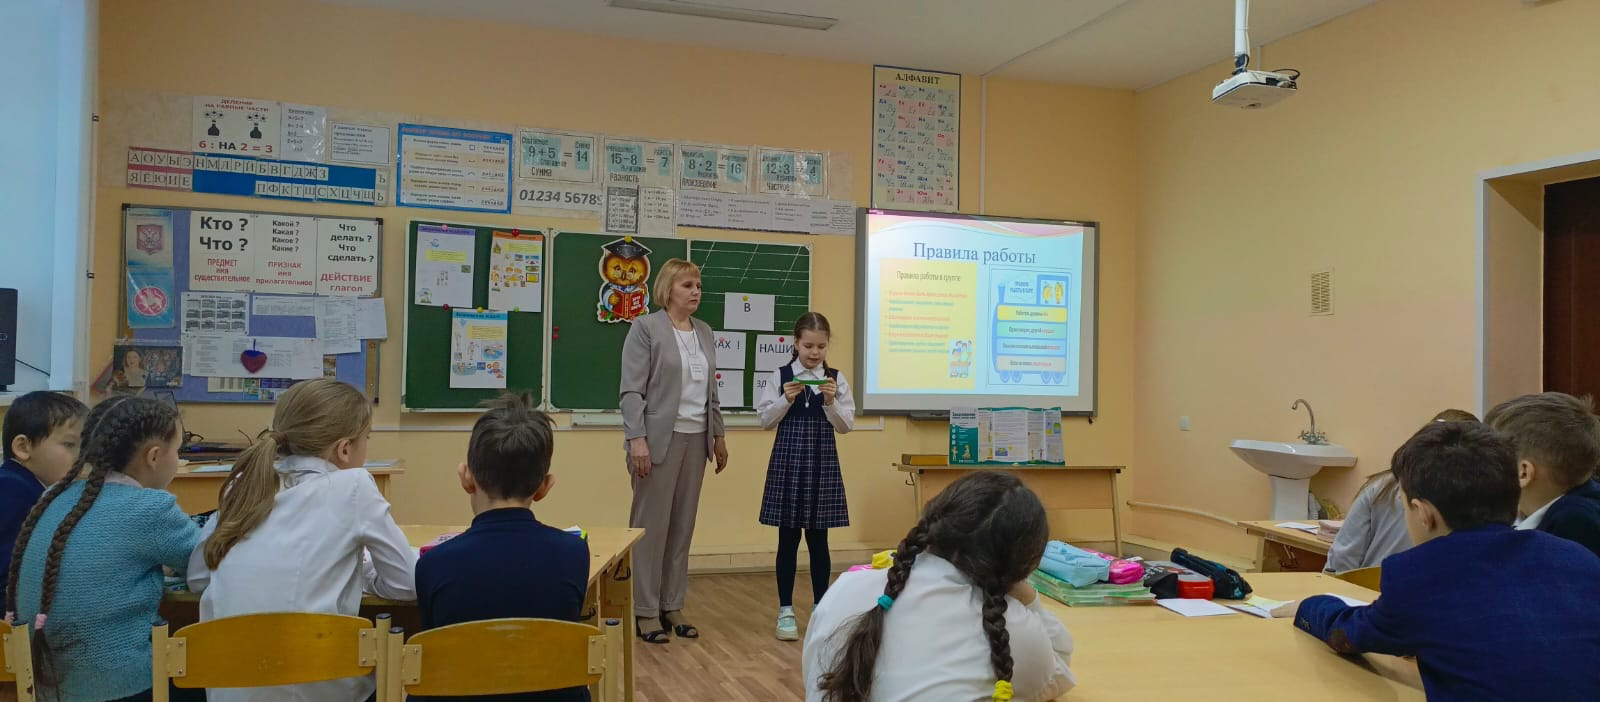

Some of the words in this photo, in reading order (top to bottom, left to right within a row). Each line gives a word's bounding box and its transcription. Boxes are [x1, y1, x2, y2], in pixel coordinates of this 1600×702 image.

[895, 73, 941, 85] АЛФАВИТ
[199, 140, 207, 149] 6
[219, 141, 236, 151] НА
[240, 143, 248, 151] 2
[265, 145, 273, 153] 3
[576, 150, 588, 162] 14
[661, 156, 668, 167] 7
[730, 162, 742, 174] 16
[200, 216, 233, 231] Кто
[239, 218, 248, 231] ?
[338, 223, 357, 232] Что
[272, 228, 294, 236] Какая
[272, 236, 294, 244] Какое
[330, 234, 365, 242] делать
[199, 236, 233, 251] Что
[239, 238, 248, 251] ?
[338, 244, 356, 252] Что
[913, 242, 979, 261] Правила
[983, 248, 1036, 265] работы
[207, 258, 237, 267] ПРЕДМЕТ
[327, 254, 367, 262] сделать
[369, 255, 374, 263] ?
[267, 261, 302, 269] ПРИЗНАК
[194, 274, 251, 283] существительное
[320, 272, 372, 283] ДЕЙСТВИЕ
[255, 278, 313, 287] прилагательное
[744, 302, 751, 312] В
